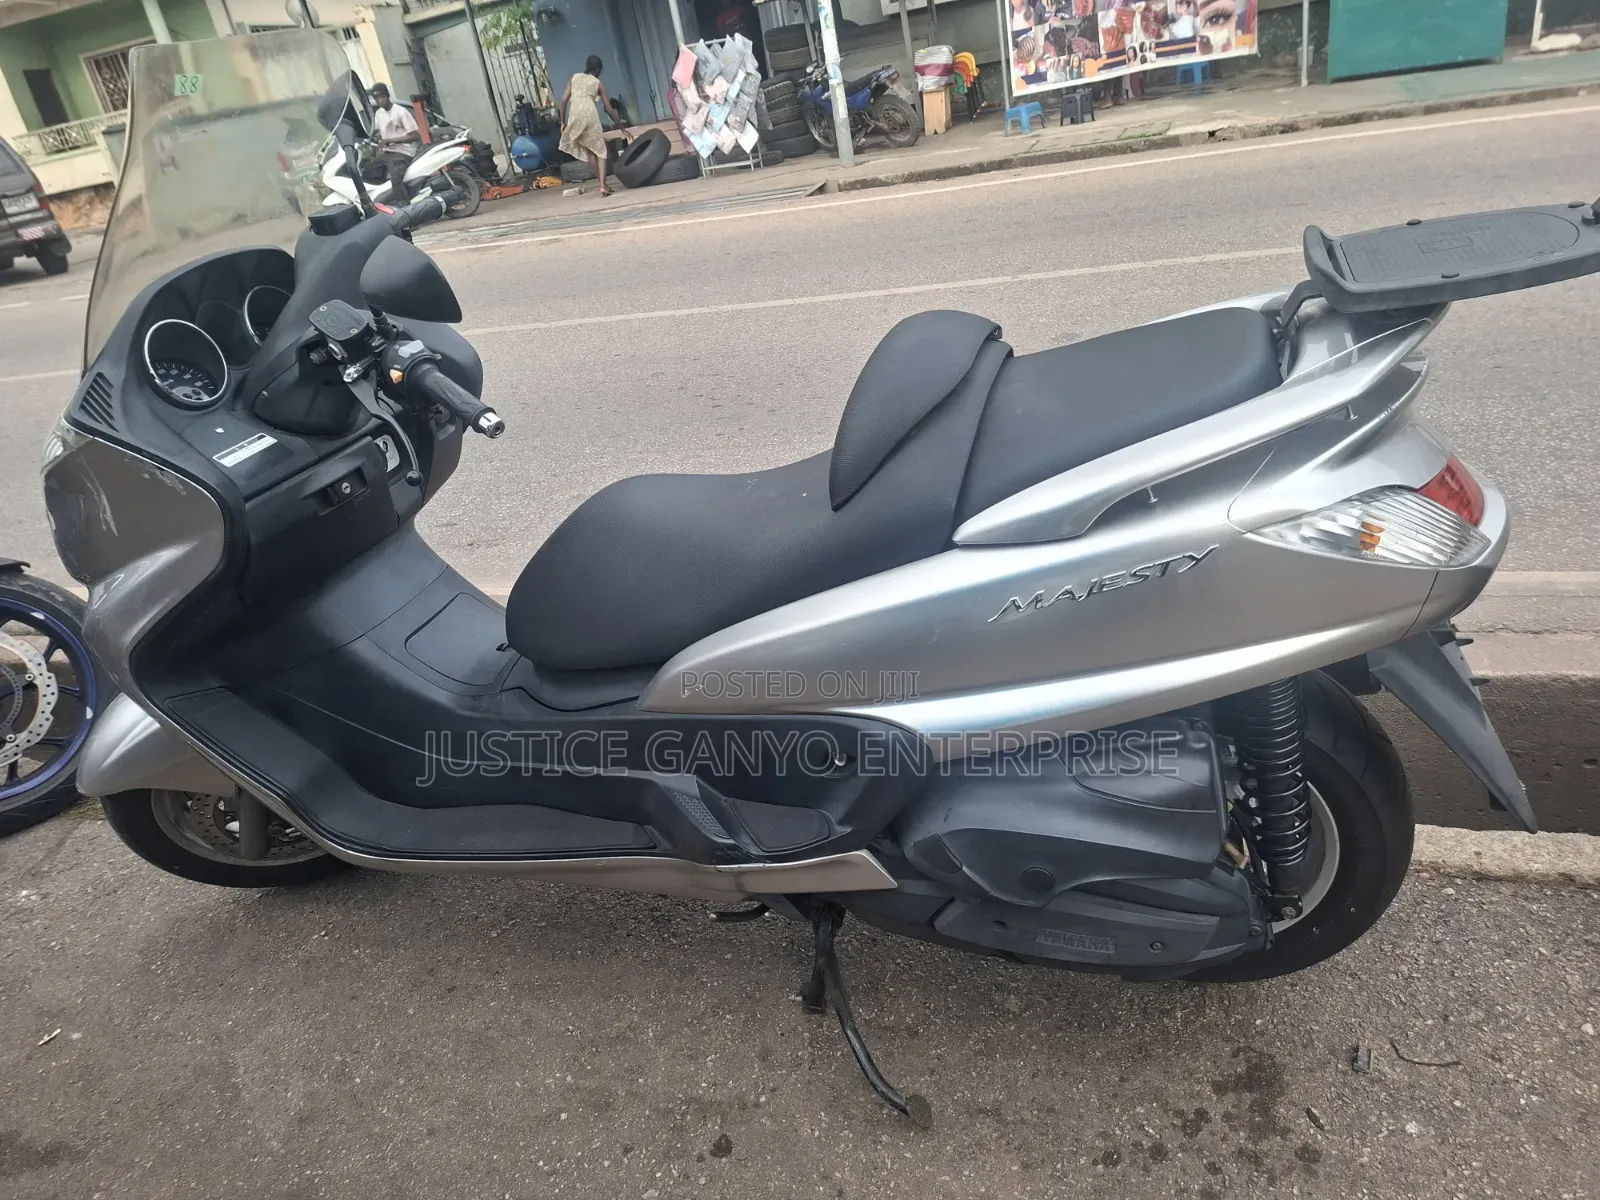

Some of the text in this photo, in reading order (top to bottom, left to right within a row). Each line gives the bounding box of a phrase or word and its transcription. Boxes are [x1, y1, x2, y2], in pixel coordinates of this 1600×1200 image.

[179, 74, 199, 95] 88
[988, 543, 1220, 623] MAJESTY
[1038, 929, 1114, 953] YAMAHA
